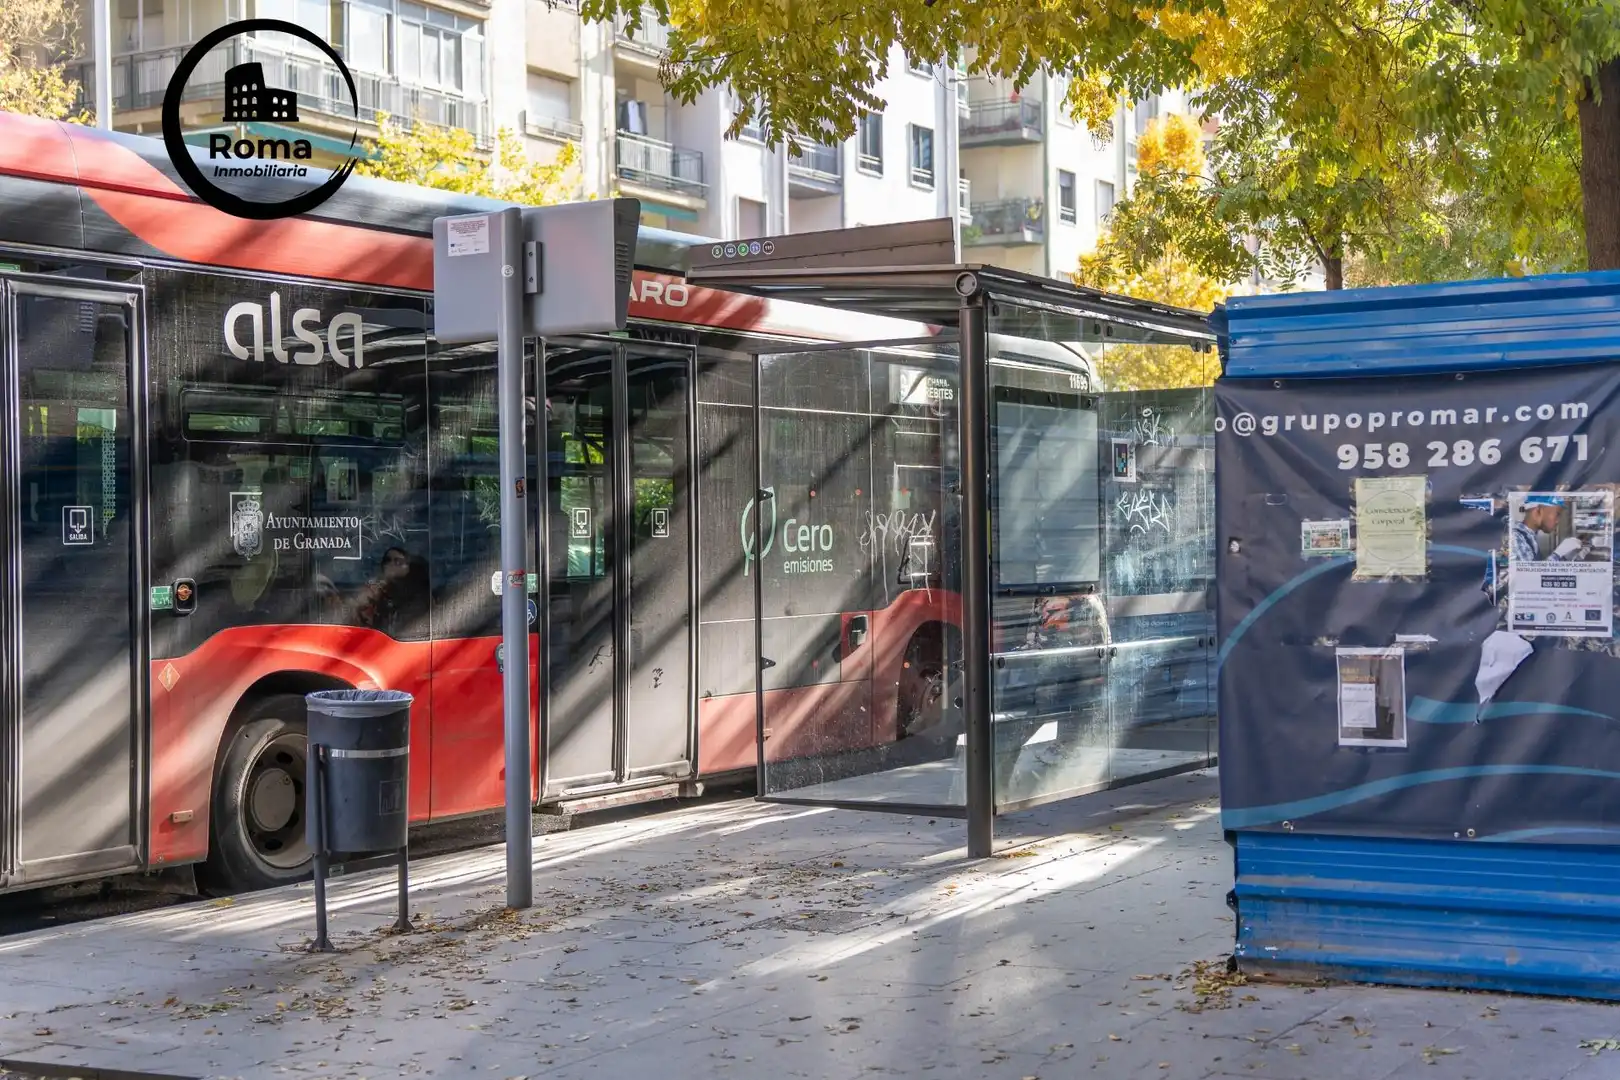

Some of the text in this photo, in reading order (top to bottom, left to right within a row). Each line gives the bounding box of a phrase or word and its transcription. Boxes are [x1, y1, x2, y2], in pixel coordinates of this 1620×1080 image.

[224, 291, 363, 369] alsa
[1337, 434, 1588, 470] 958 286 671
[265, 512, 359, 529] AYUNTAMIENTO
[69, 533, 88, 541] SALIDA
[294, 533, 351, 549] GRANADA
[784, 519, 833, 552] Cero
[784, 557, 833, 574] emisiones
